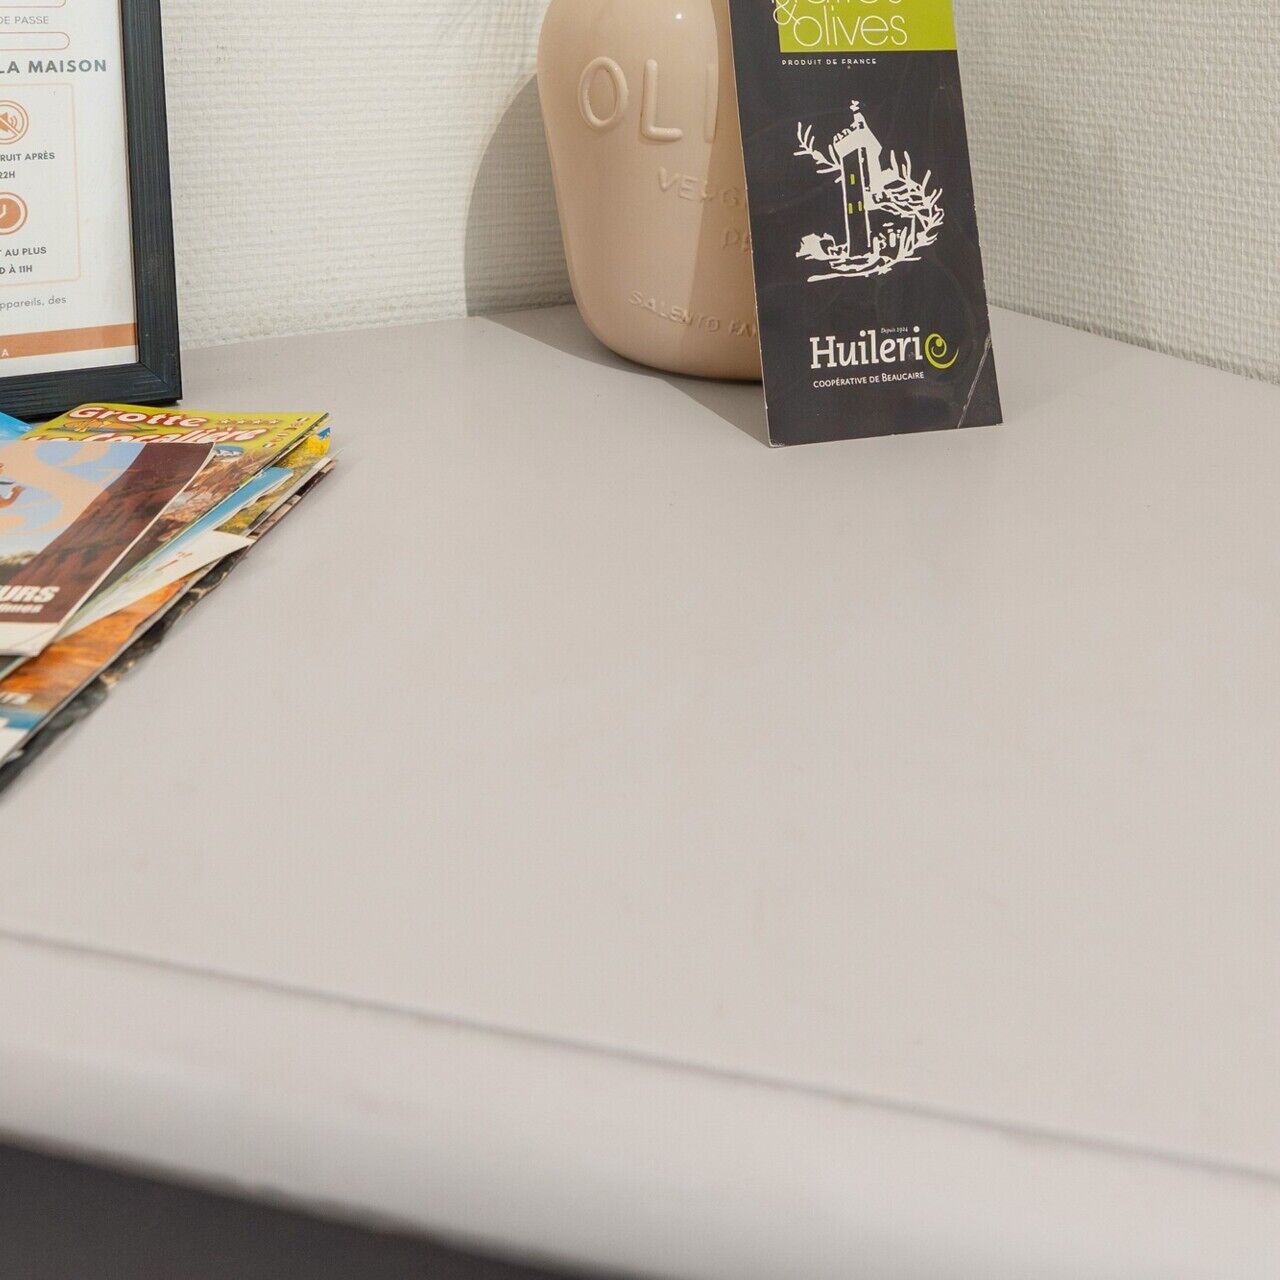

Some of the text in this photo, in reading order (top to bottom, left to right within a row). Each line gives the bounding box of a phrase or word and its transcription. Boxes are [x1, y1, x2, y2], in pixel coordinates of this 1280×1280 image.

[14, 15, 50, 25] PASSE
[793, 5, 908, 47] olives
[28, 58, 107, 74] MAISON
[781, 58, 822, 66] PRODUIT
[841, 57, 877, 65] FRANCE
[24, 151, 56, 162] APRÈS
[4, 247, 19, 257] AU
[22, 246, 47, 256] PLUS
[8, 263, 17, 274] À
[18, 264, 33, 274] 11H
[48, 295, 67, 306] des
[809, 325, 960, 370] Huilerie
[813, 376, 868, 388] COOPÉRATIVE
[869, 375, 880, 384] DE
[69, 406, 207, 428] Grotte
